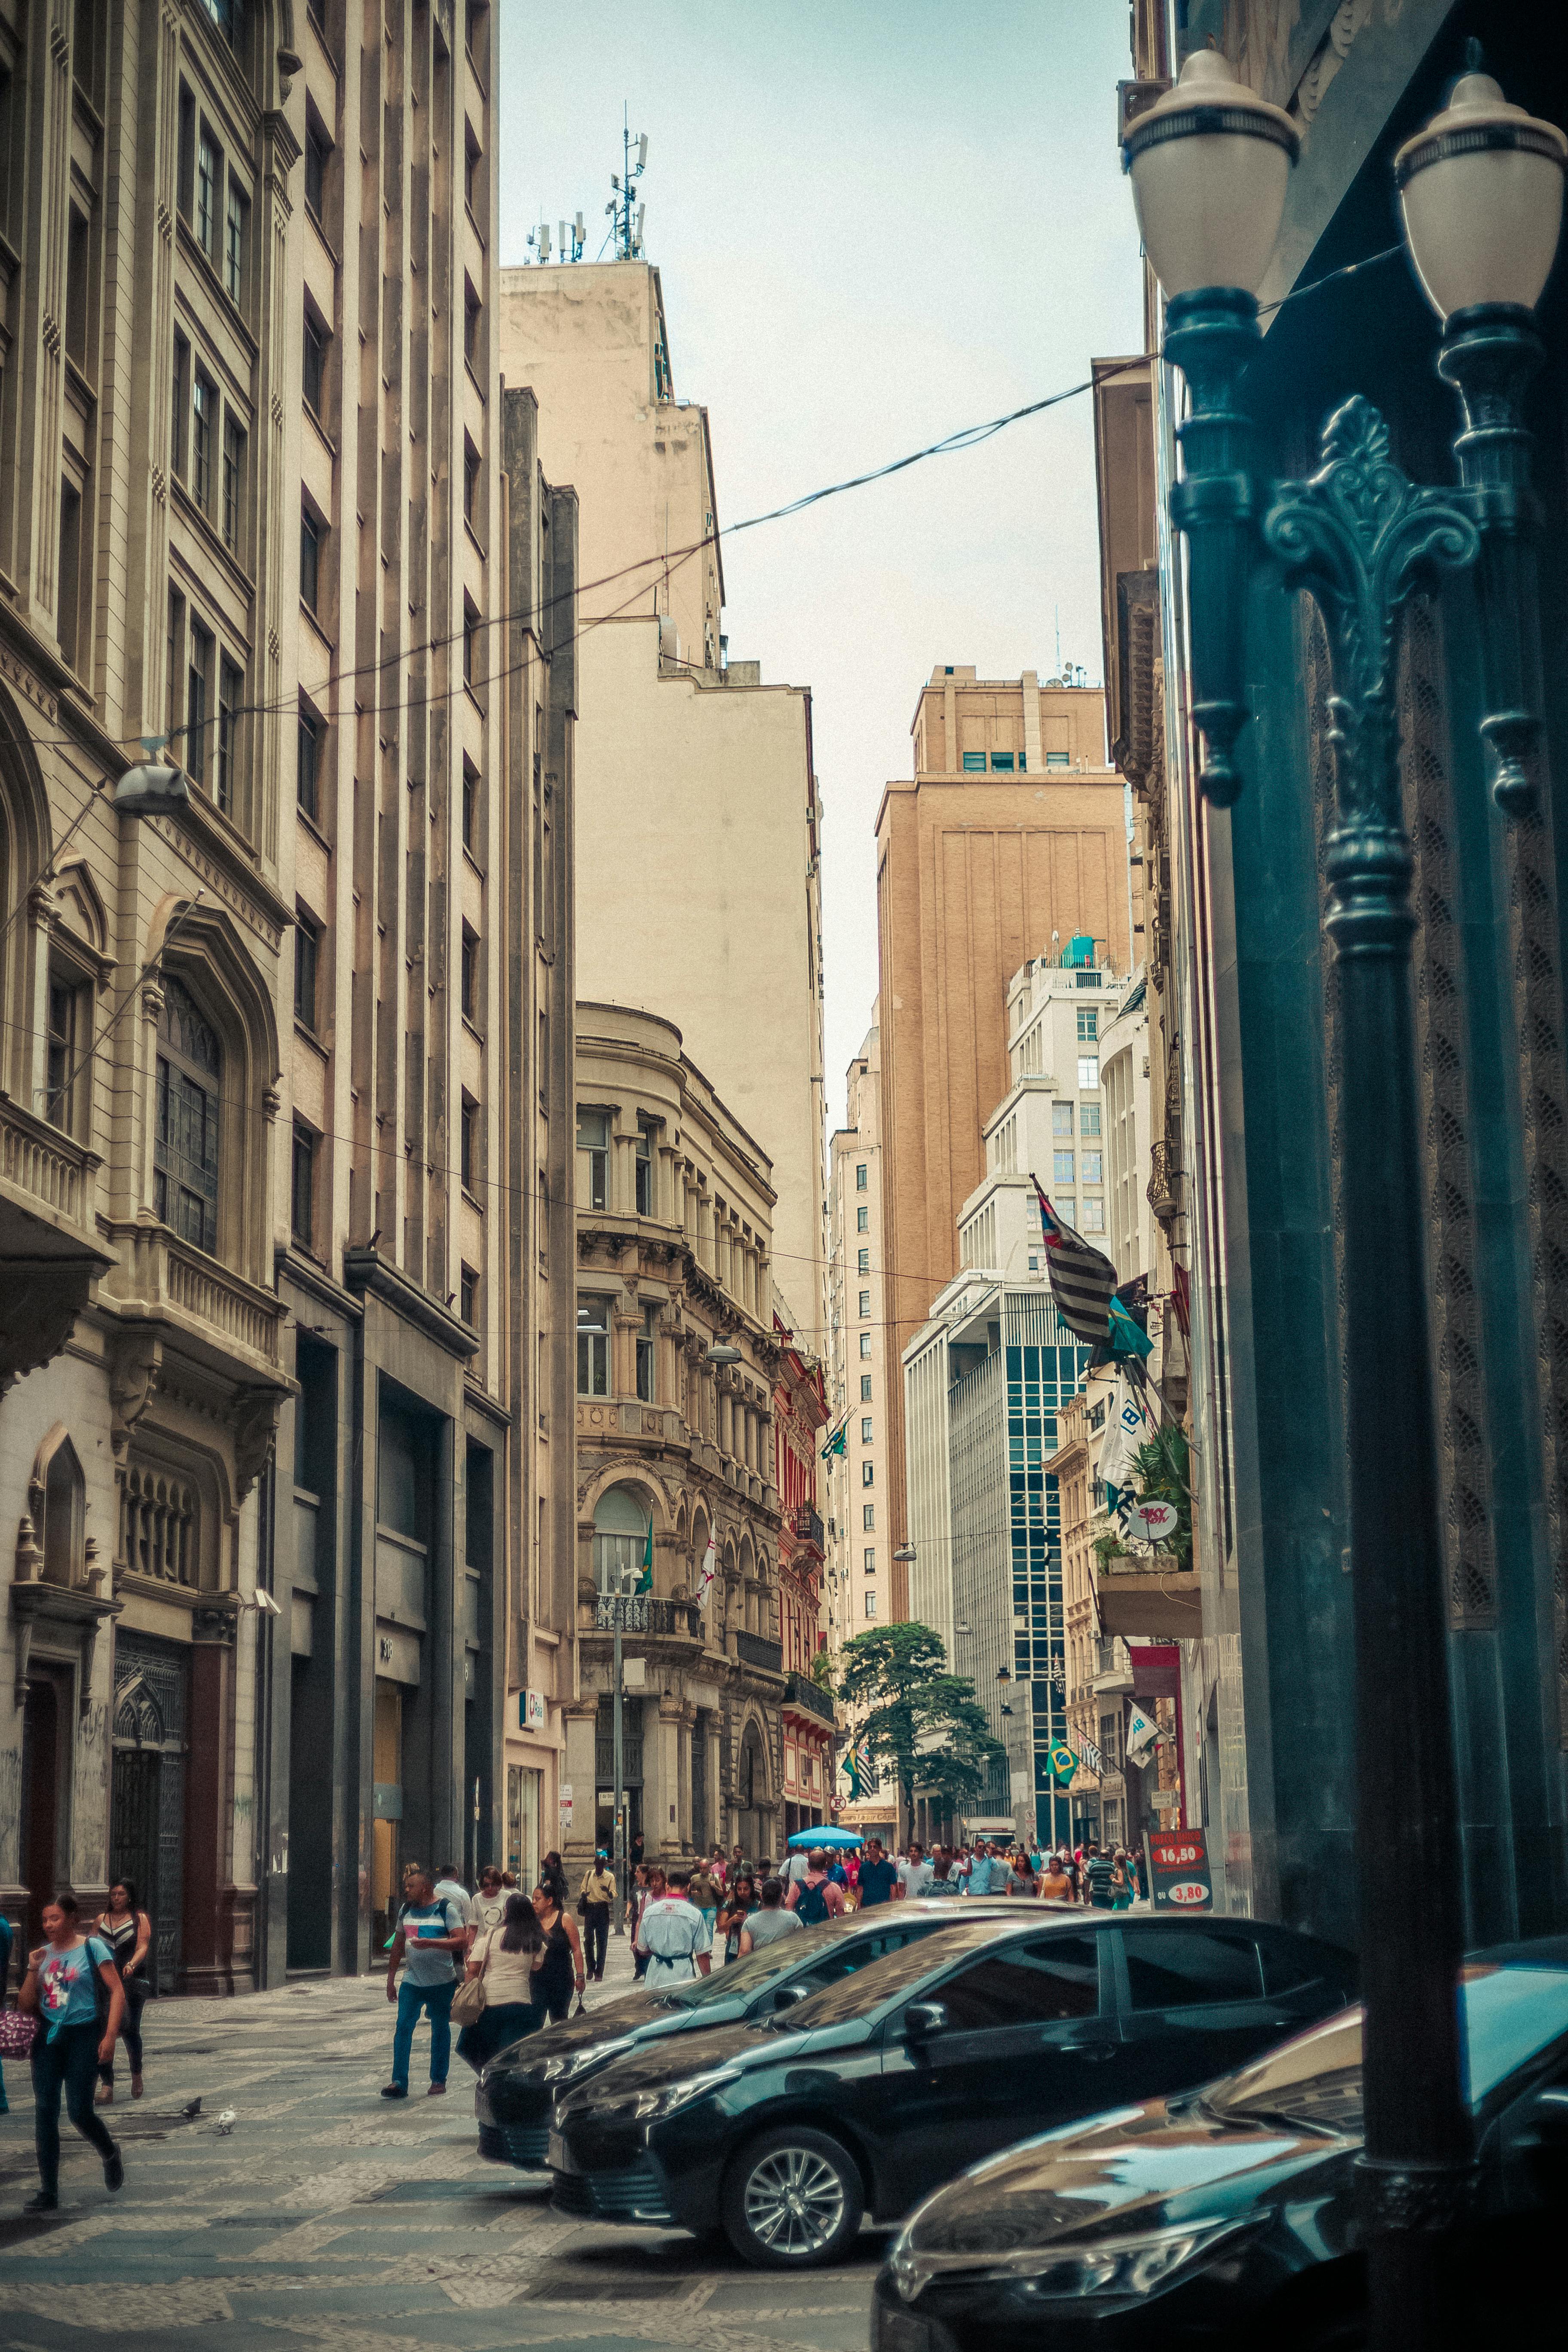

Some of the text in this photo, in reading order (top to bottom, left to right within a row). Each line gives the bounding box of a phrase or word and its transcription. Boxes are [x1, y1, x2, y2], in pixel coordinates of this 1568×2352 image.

[1138, 1506, 1170, 1519] SKY
[383, 1638, 392, 1658] 318
[1161, 1847, 1196, 1864] 16,50
[1176, 1886, 1202, 1902] 3,80
